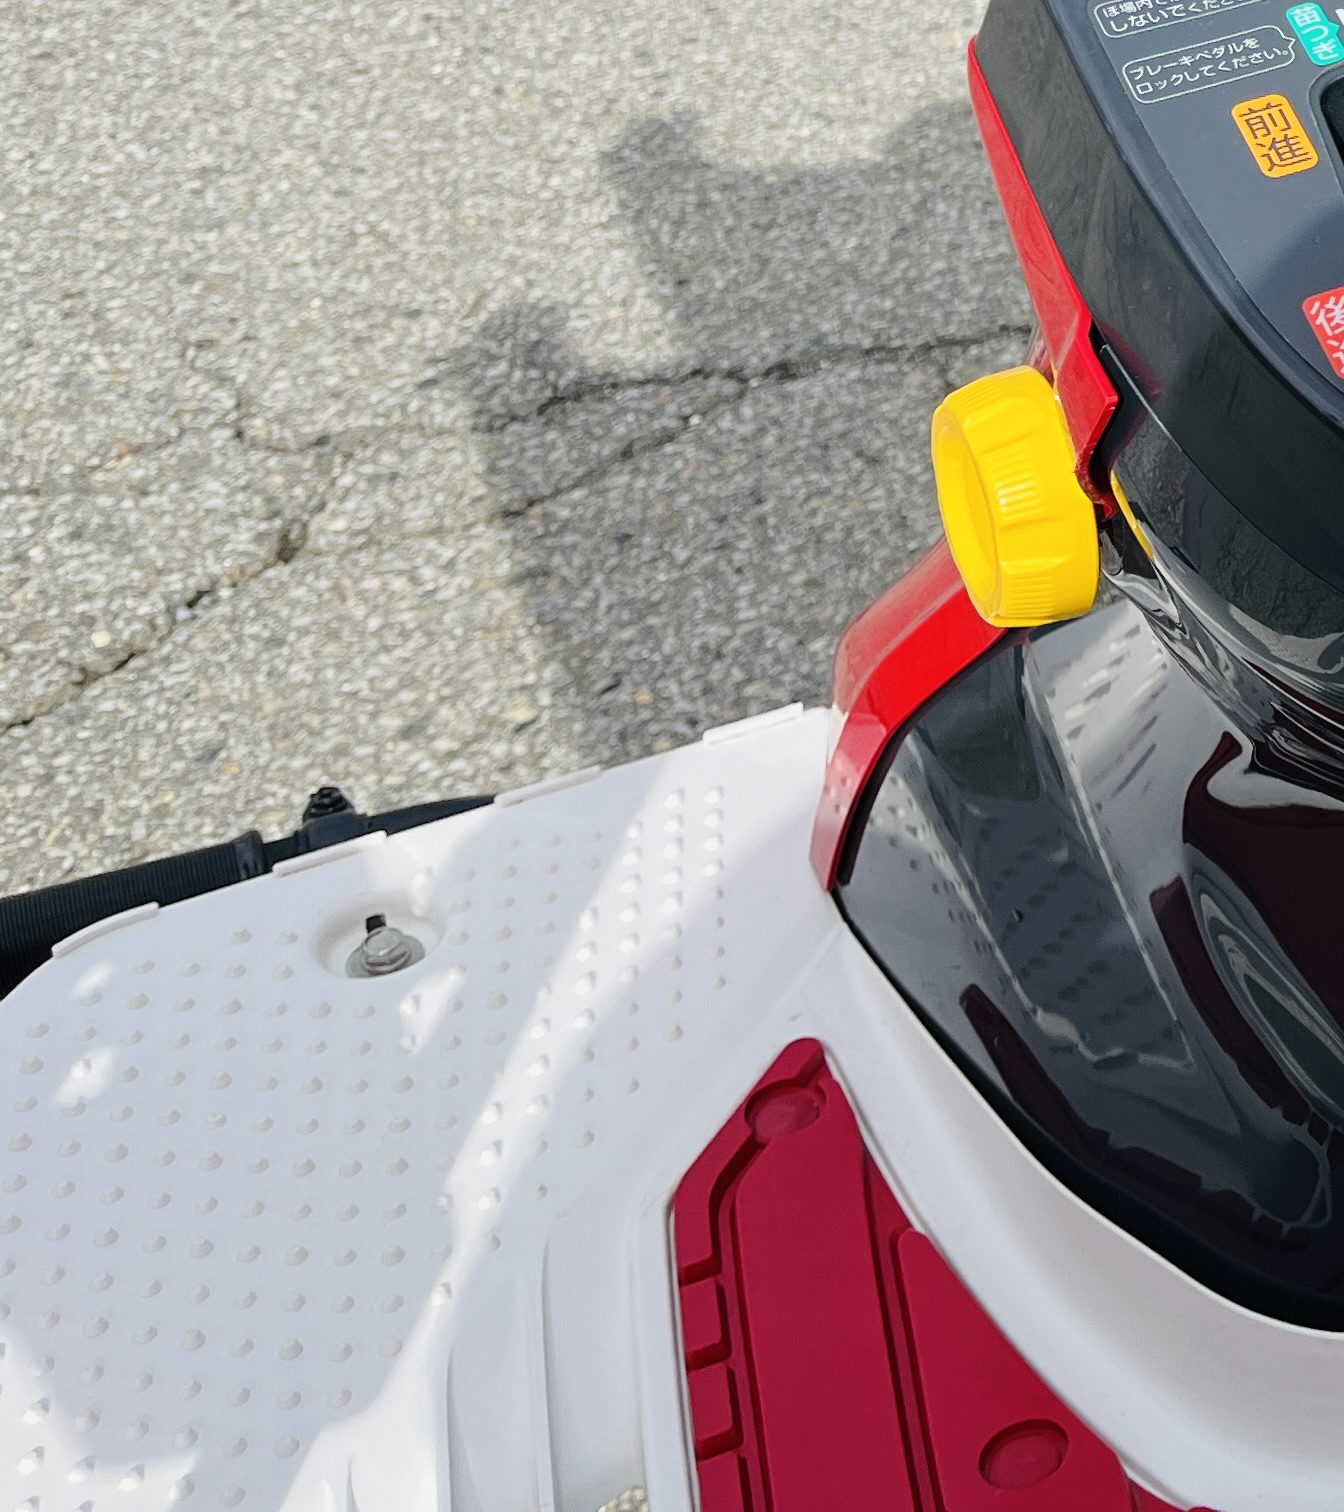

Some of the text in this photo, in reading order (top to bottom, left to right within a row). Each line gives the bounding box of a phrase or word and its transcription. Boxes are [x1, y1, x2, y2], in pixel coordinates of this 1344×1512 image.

[1129, 37, 1261, 81] ブレーキペダルを
[1297, 4, 1339, 62] 苗つぎ
[1135, 47, 1289, 95] ロックしてください。
[1239, 100, 1313, 172] 前進
